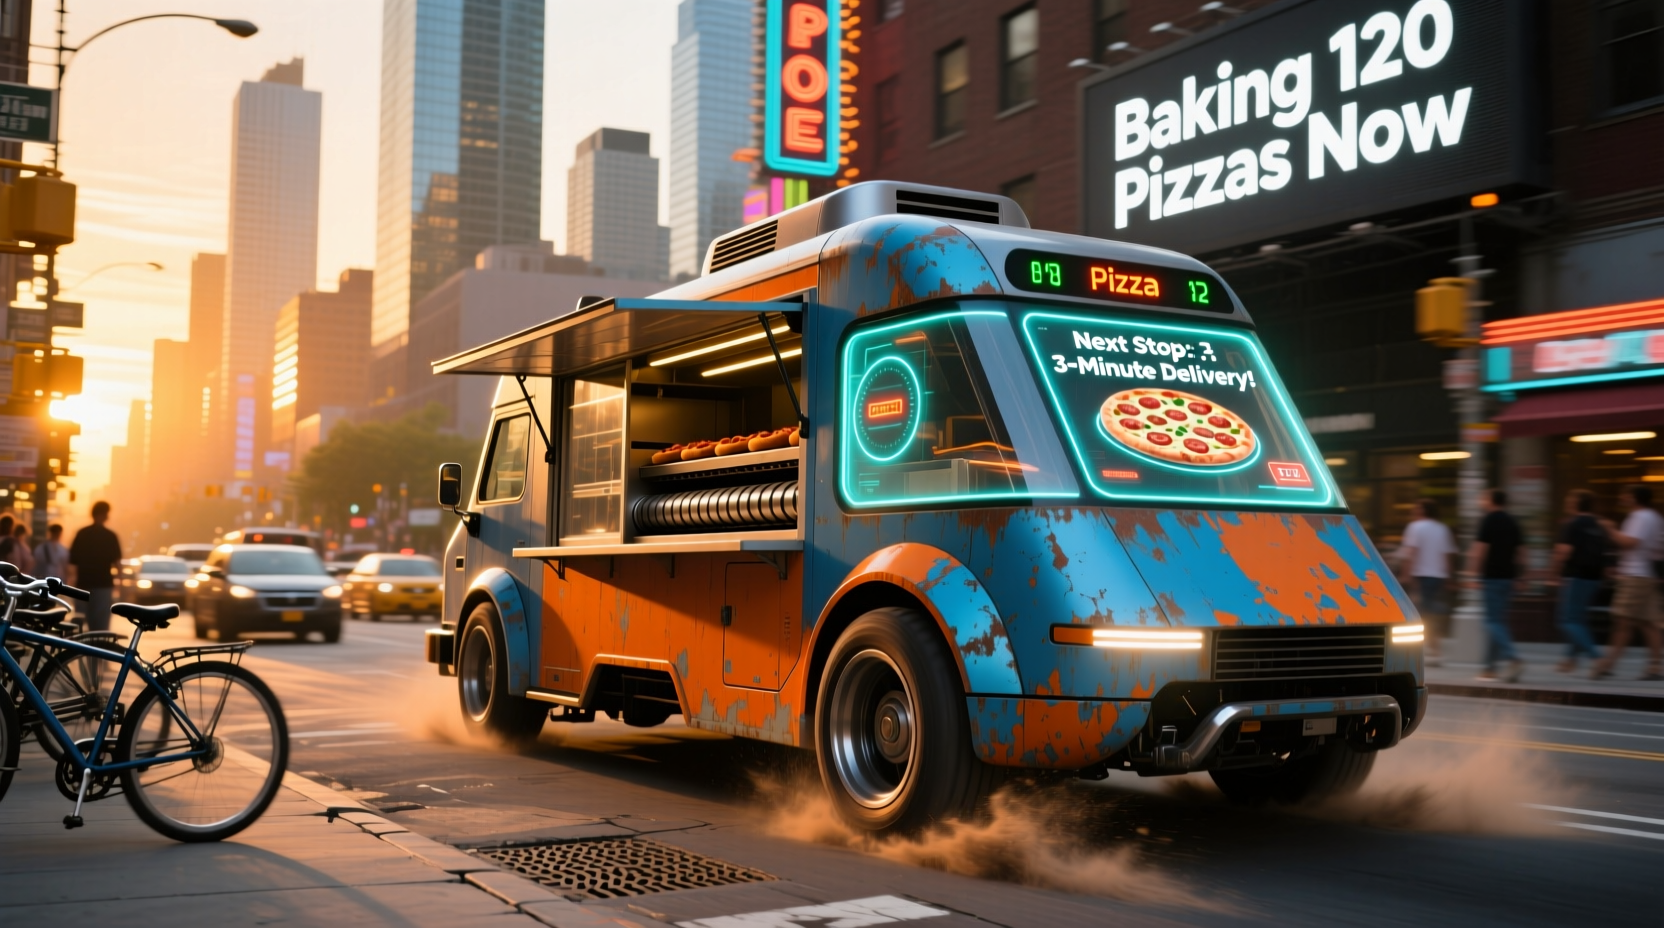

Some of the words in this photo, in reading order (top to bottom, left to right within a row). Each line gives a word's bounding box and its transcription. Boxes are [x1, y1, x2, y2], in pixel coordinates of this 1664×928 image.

[782, 3, 829, 153] POE
[1115, 53, 1312, 162] Baking
[1329, 0, 1453, 92] 120
[1115, 139, 1292, 229] Pizzas
[1308, 87, 1473, 180] Now
[1091, 266, 1159, 297] Pizza
[1189, 281, 1209, 304] 12
[1051, 354, 1157, 380] 3-Minute
[1159, 362, 1257, 392] Delivery!
[1072, 330, 1129, 353] Next
